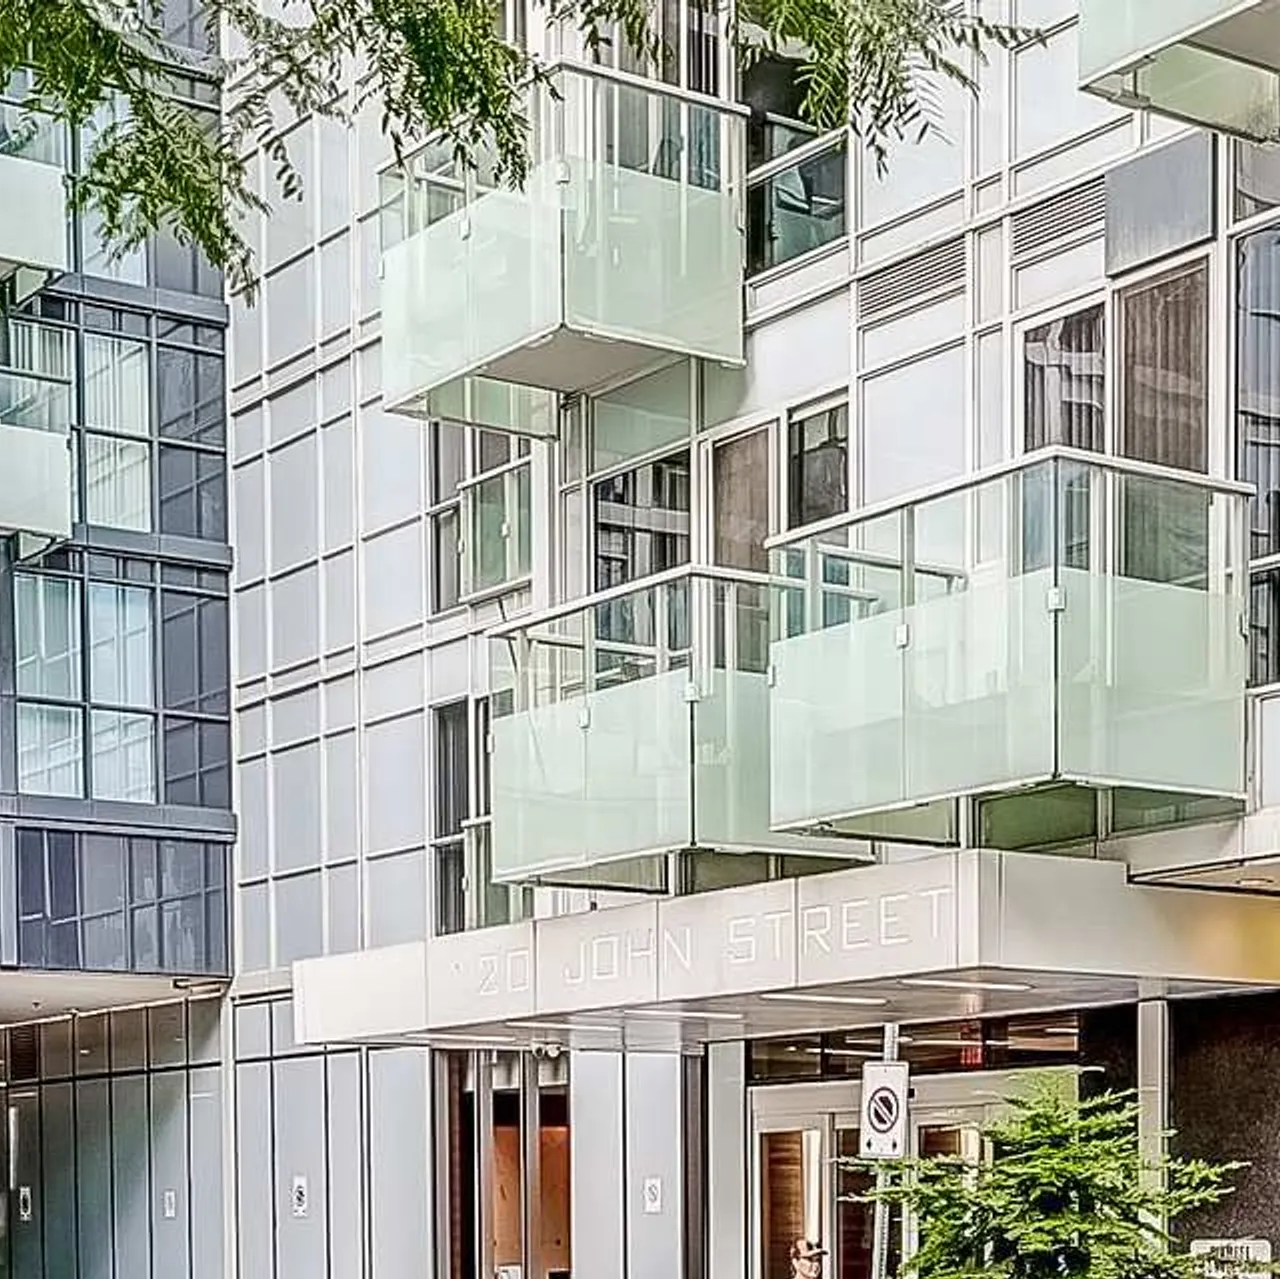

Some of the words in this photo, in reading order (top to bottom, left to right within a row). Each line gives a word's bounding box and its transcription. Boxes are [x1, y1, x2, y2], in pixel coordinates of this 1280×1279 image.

[454, 947, 530, 996] 20
[562, 927, 693, 985] JOHN
[723, 885, 953, 964] STREET
